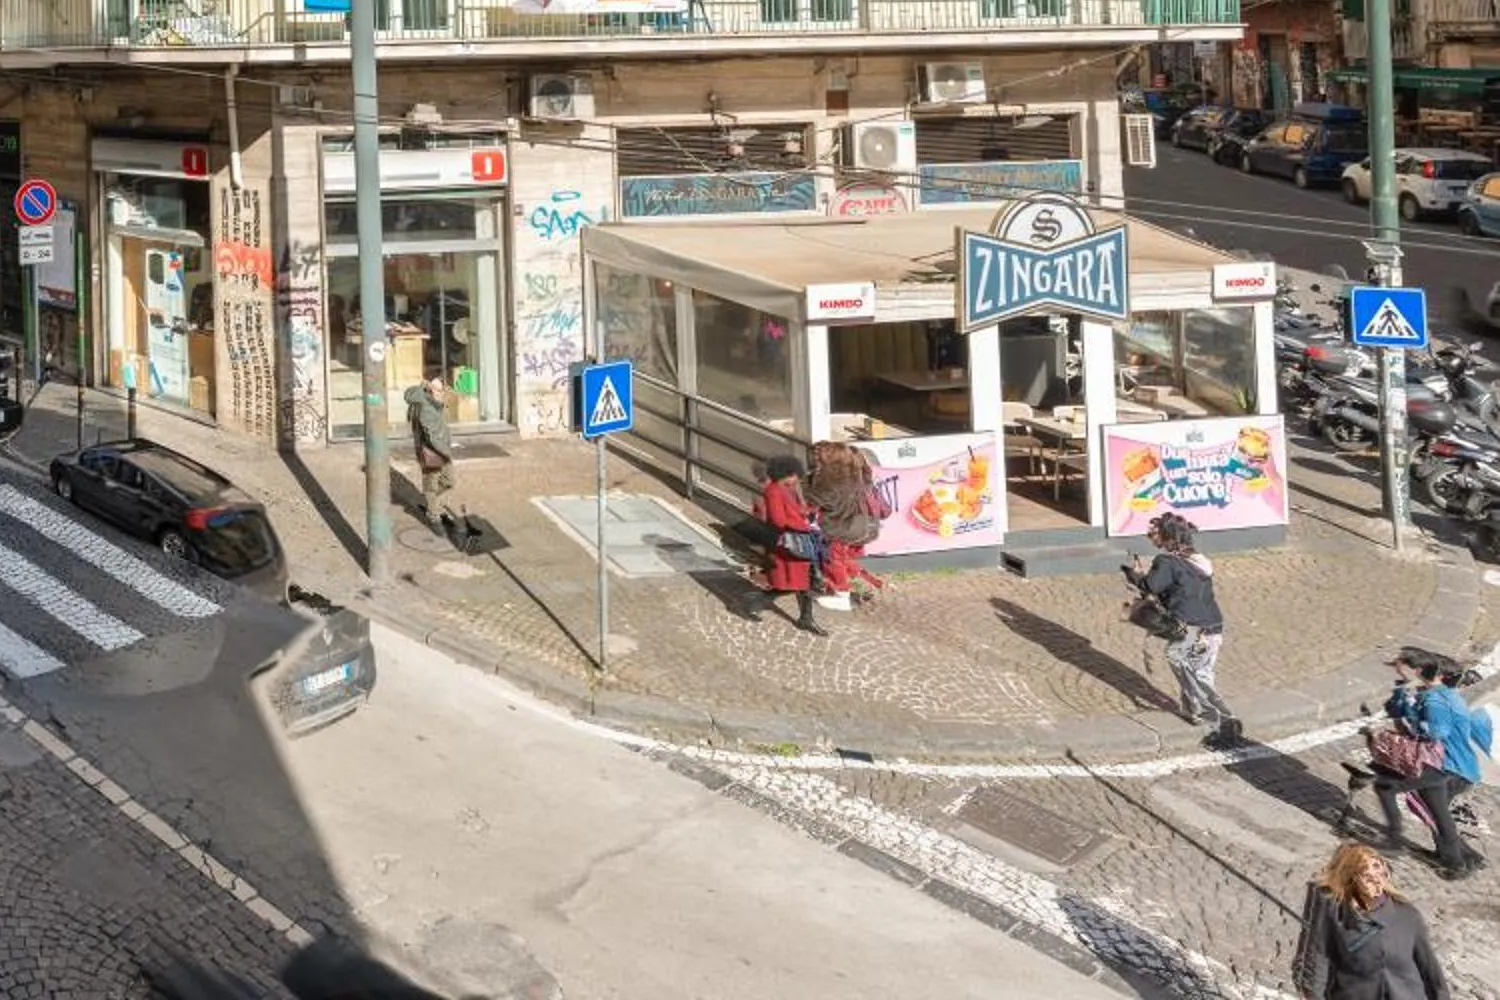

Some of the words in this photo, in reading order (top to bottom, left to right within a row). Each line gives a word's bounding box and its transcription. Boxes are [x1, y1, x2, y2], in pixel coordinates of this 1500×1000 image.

[1029, 208, 1063, 244] S
[975, 240, 1120, 313] ZINGARA
[819, 299, 863, 309] KIMBO
